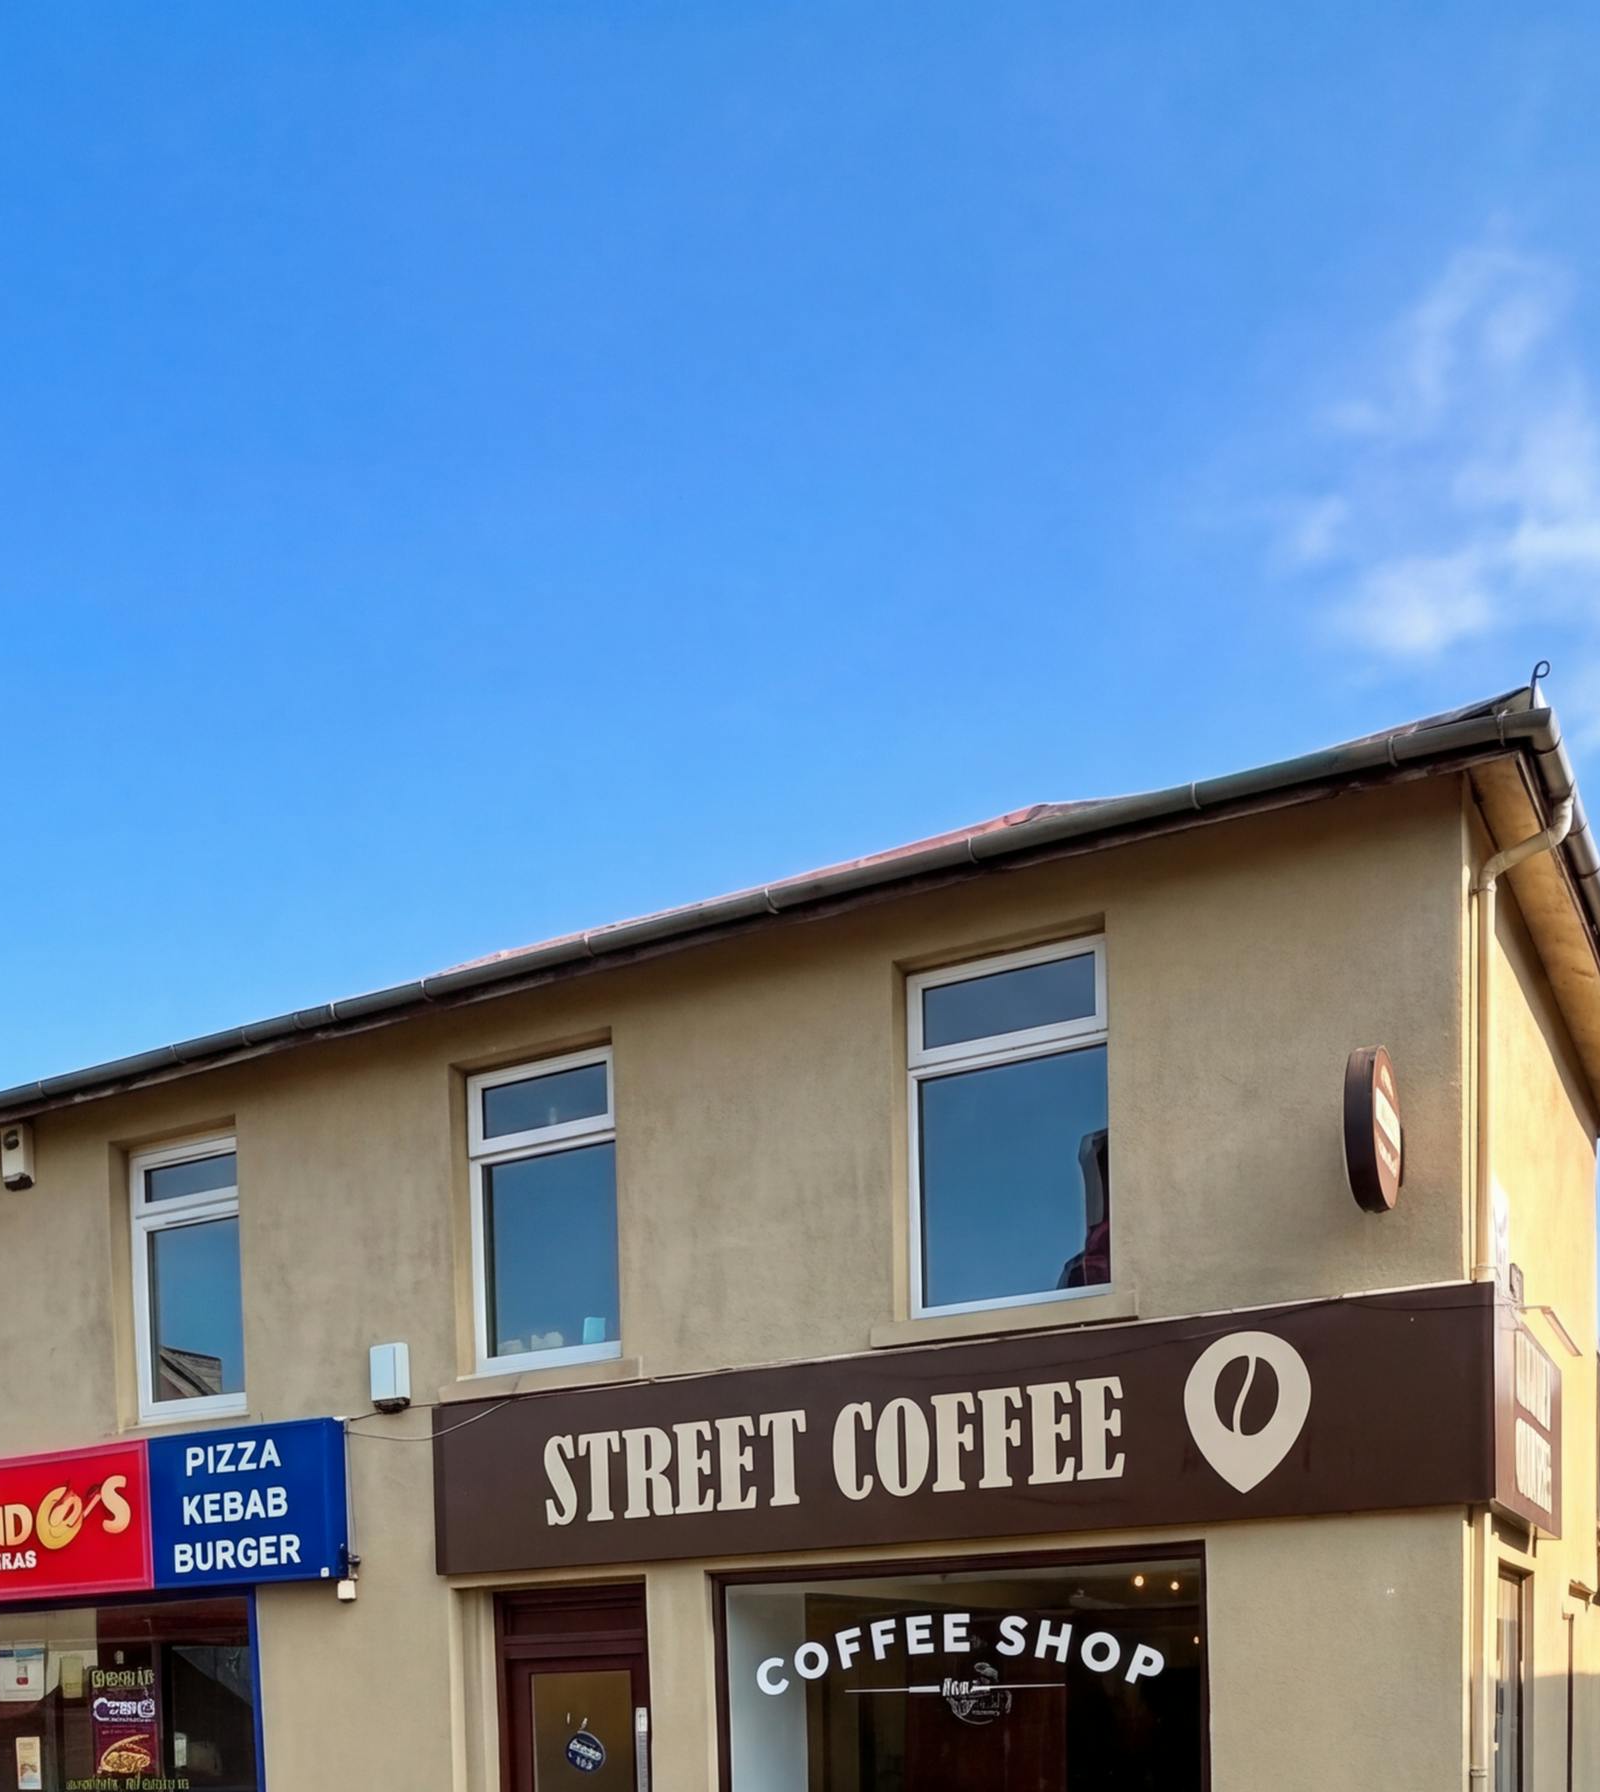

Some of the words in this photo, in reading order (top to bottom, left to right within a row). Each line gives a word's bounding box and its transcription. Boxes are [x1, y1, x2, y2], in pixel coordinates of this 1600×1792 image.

[185, 1438, 282, 1477] PIZZA
[542, 1409, 807, 1526] STREET
[832, 1376, 1126, 1501] COFFEE
[181, 1486, 288, 1526] KEBAB
[173, 1533, 301, 1573] BURGER
[756, 1613, 971, 1696] COFFEE
[996, 1615, 1165, 1685] SHOP
